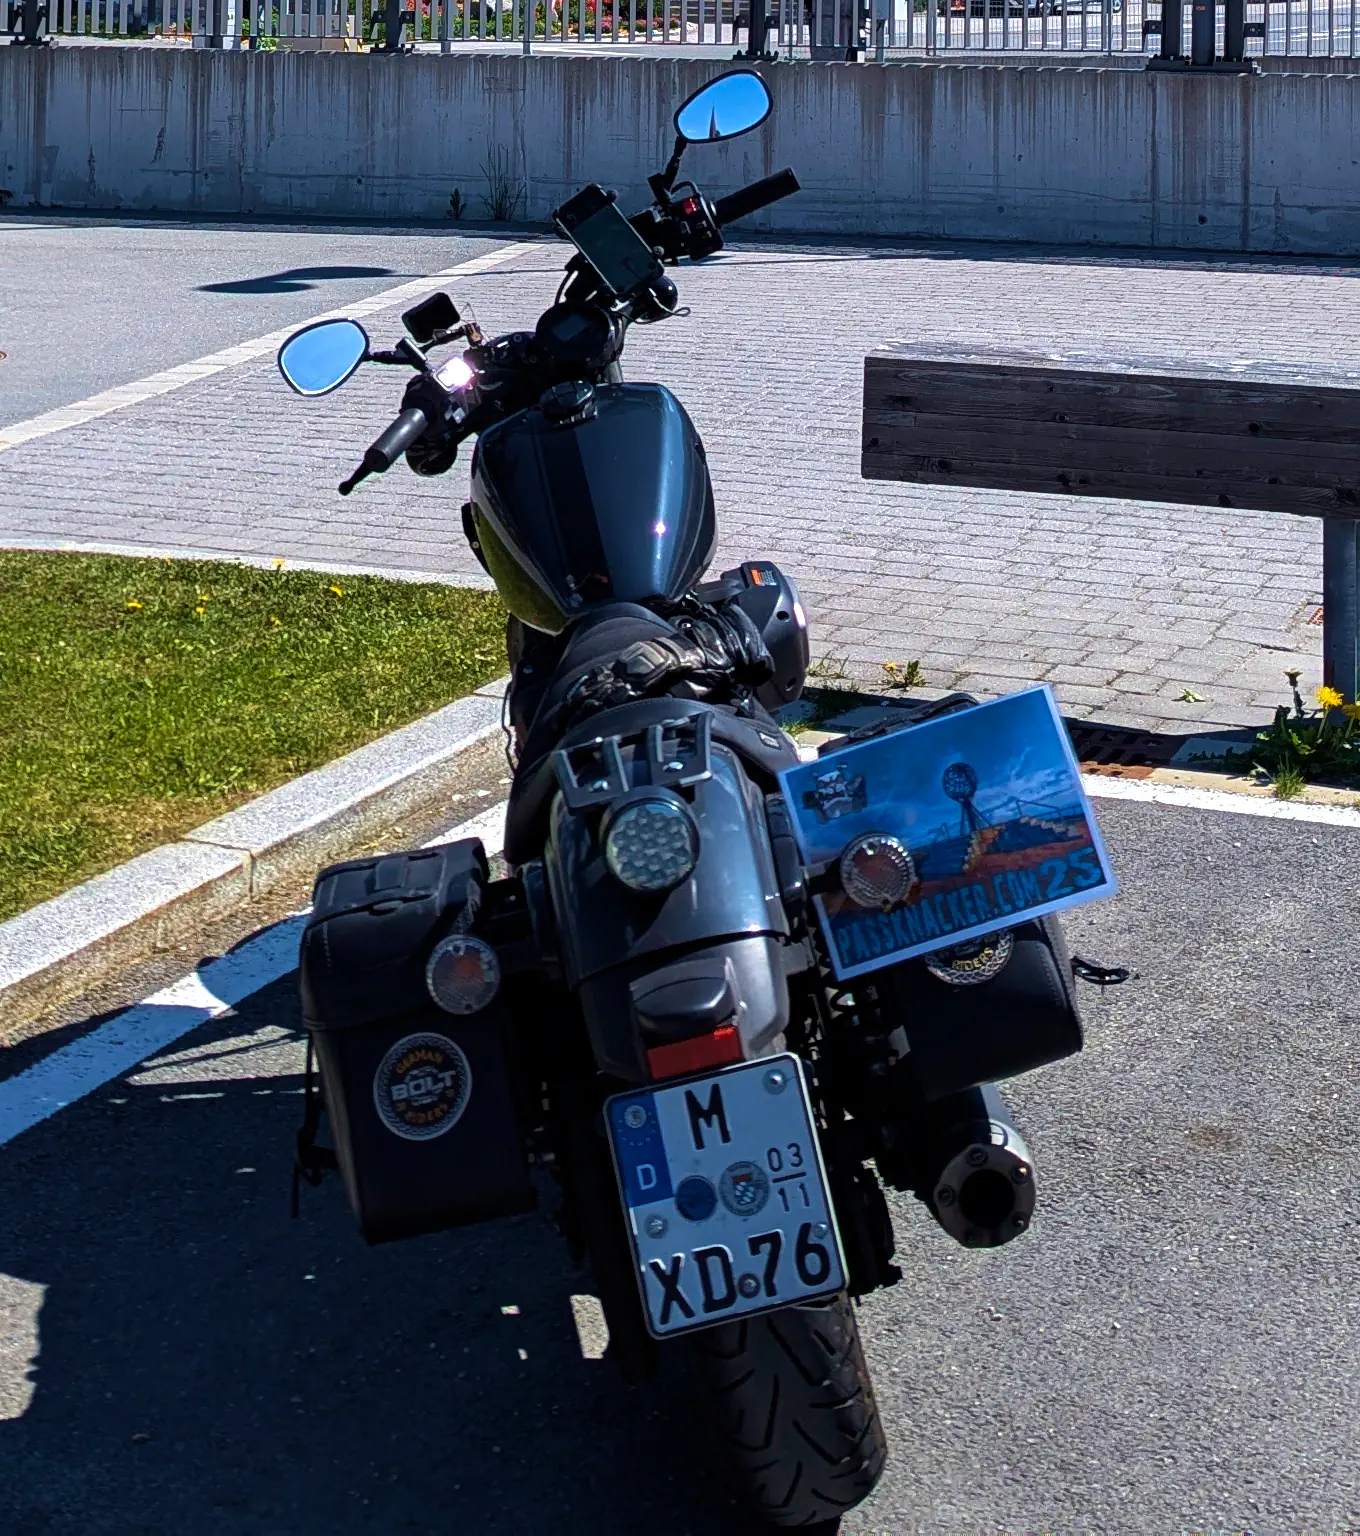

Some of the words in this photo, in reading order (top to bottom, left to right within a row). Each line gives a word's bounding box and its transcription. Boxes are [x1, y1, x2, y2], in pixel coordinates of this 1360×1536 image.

[1040, 848, 1102, 899] 25
[390, 1070, 456, 1101] BOLT
[684, 1083, 731, 1150] M
[766, 1143, 803, 1172] 03
[636, 1164, 657, 1191] D
[778, 1183, 810, 1212] 11
[648, 1243, 737, 1325] XD
[748, 1222, 830, 1298] 76
